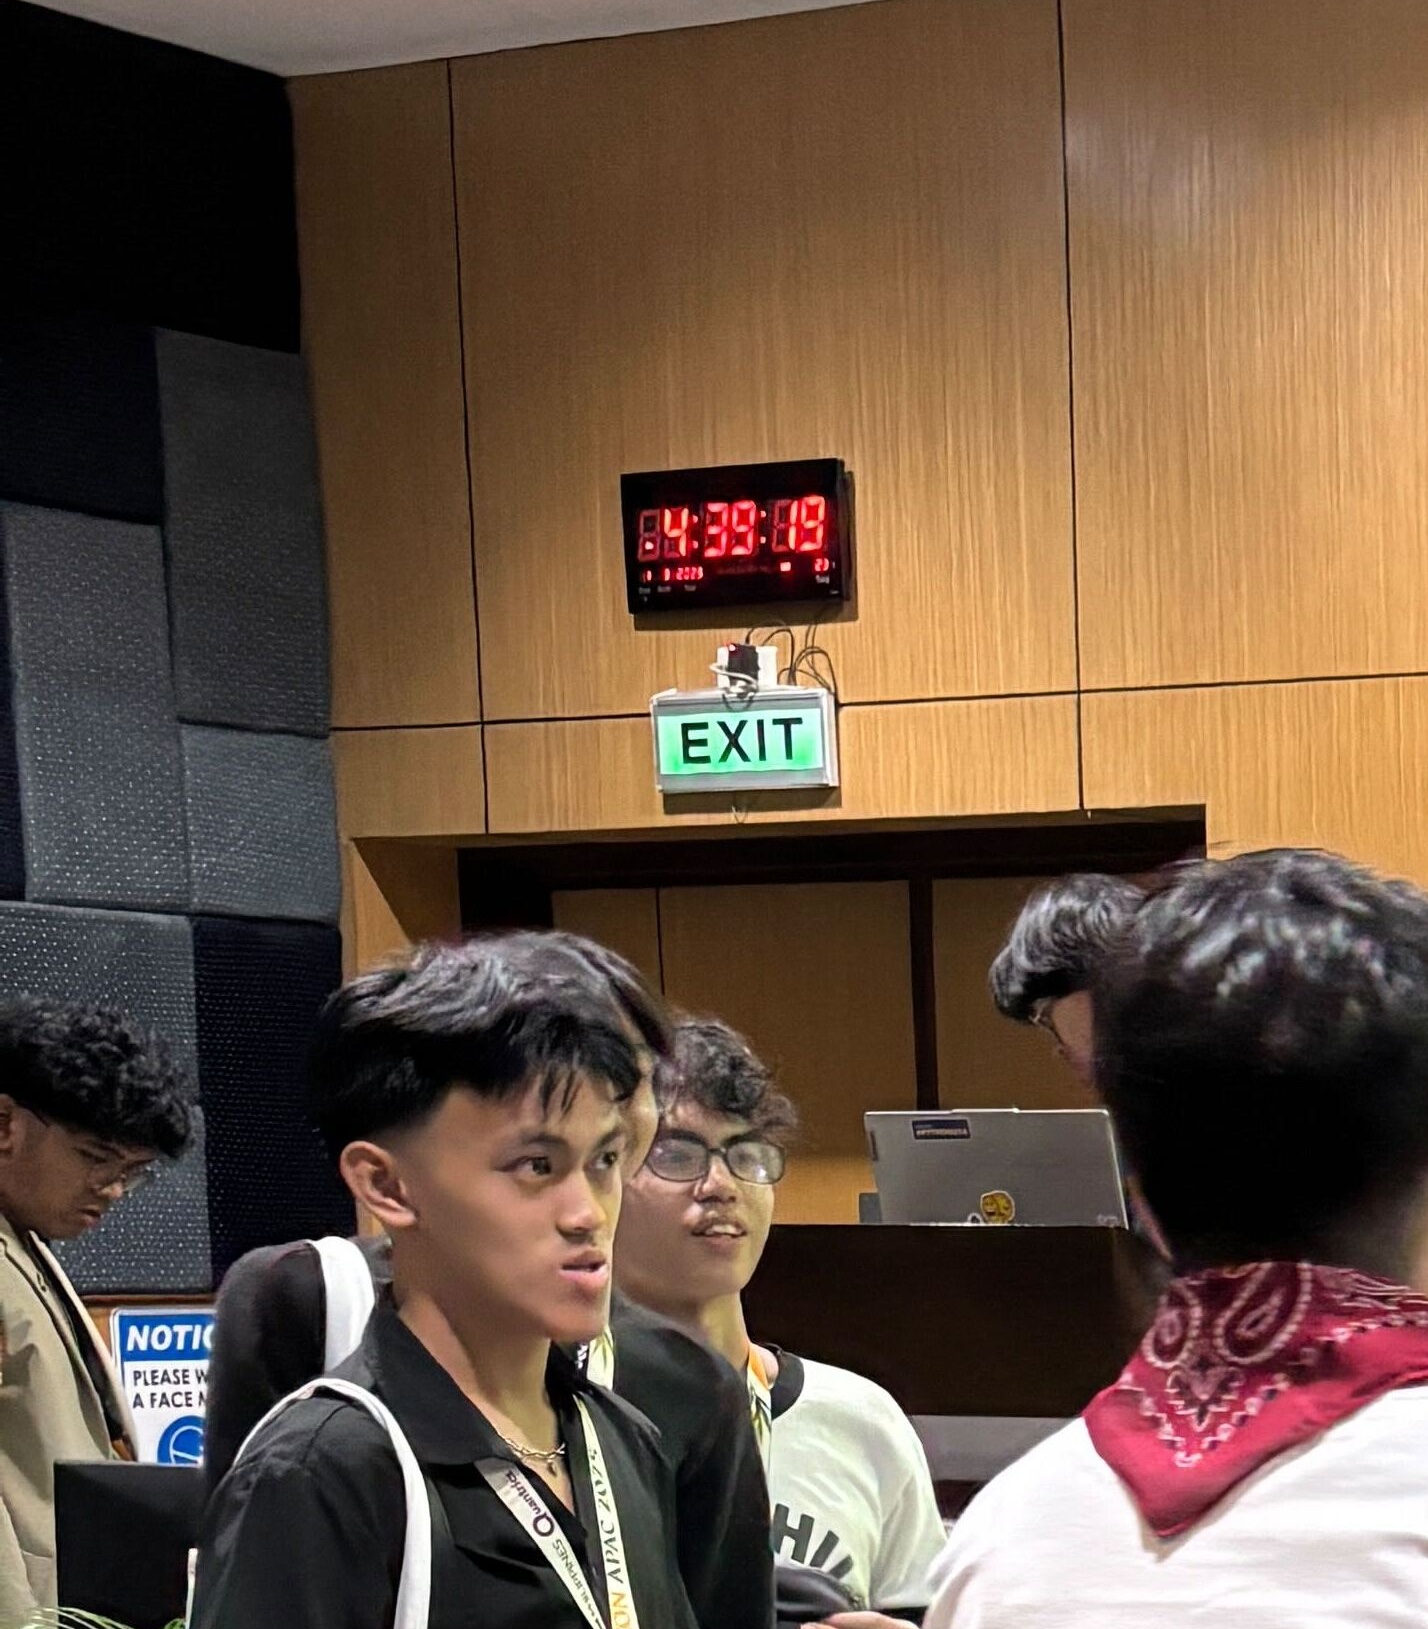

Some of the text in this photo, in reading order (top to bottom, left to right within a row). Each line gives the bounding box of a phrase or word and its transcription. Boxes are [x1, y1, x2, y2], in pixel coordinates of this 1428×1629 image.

[680, 717, 803, 765] EXIT
[127, 1324, 215, 1352] NOTIC
[133, 1369, 191, 1387] PLEASE
[132, 1392, 145, 1410] A
[149, 1391, 193, 1409] FACE
[601, 1518, 624, 1584] APAC
